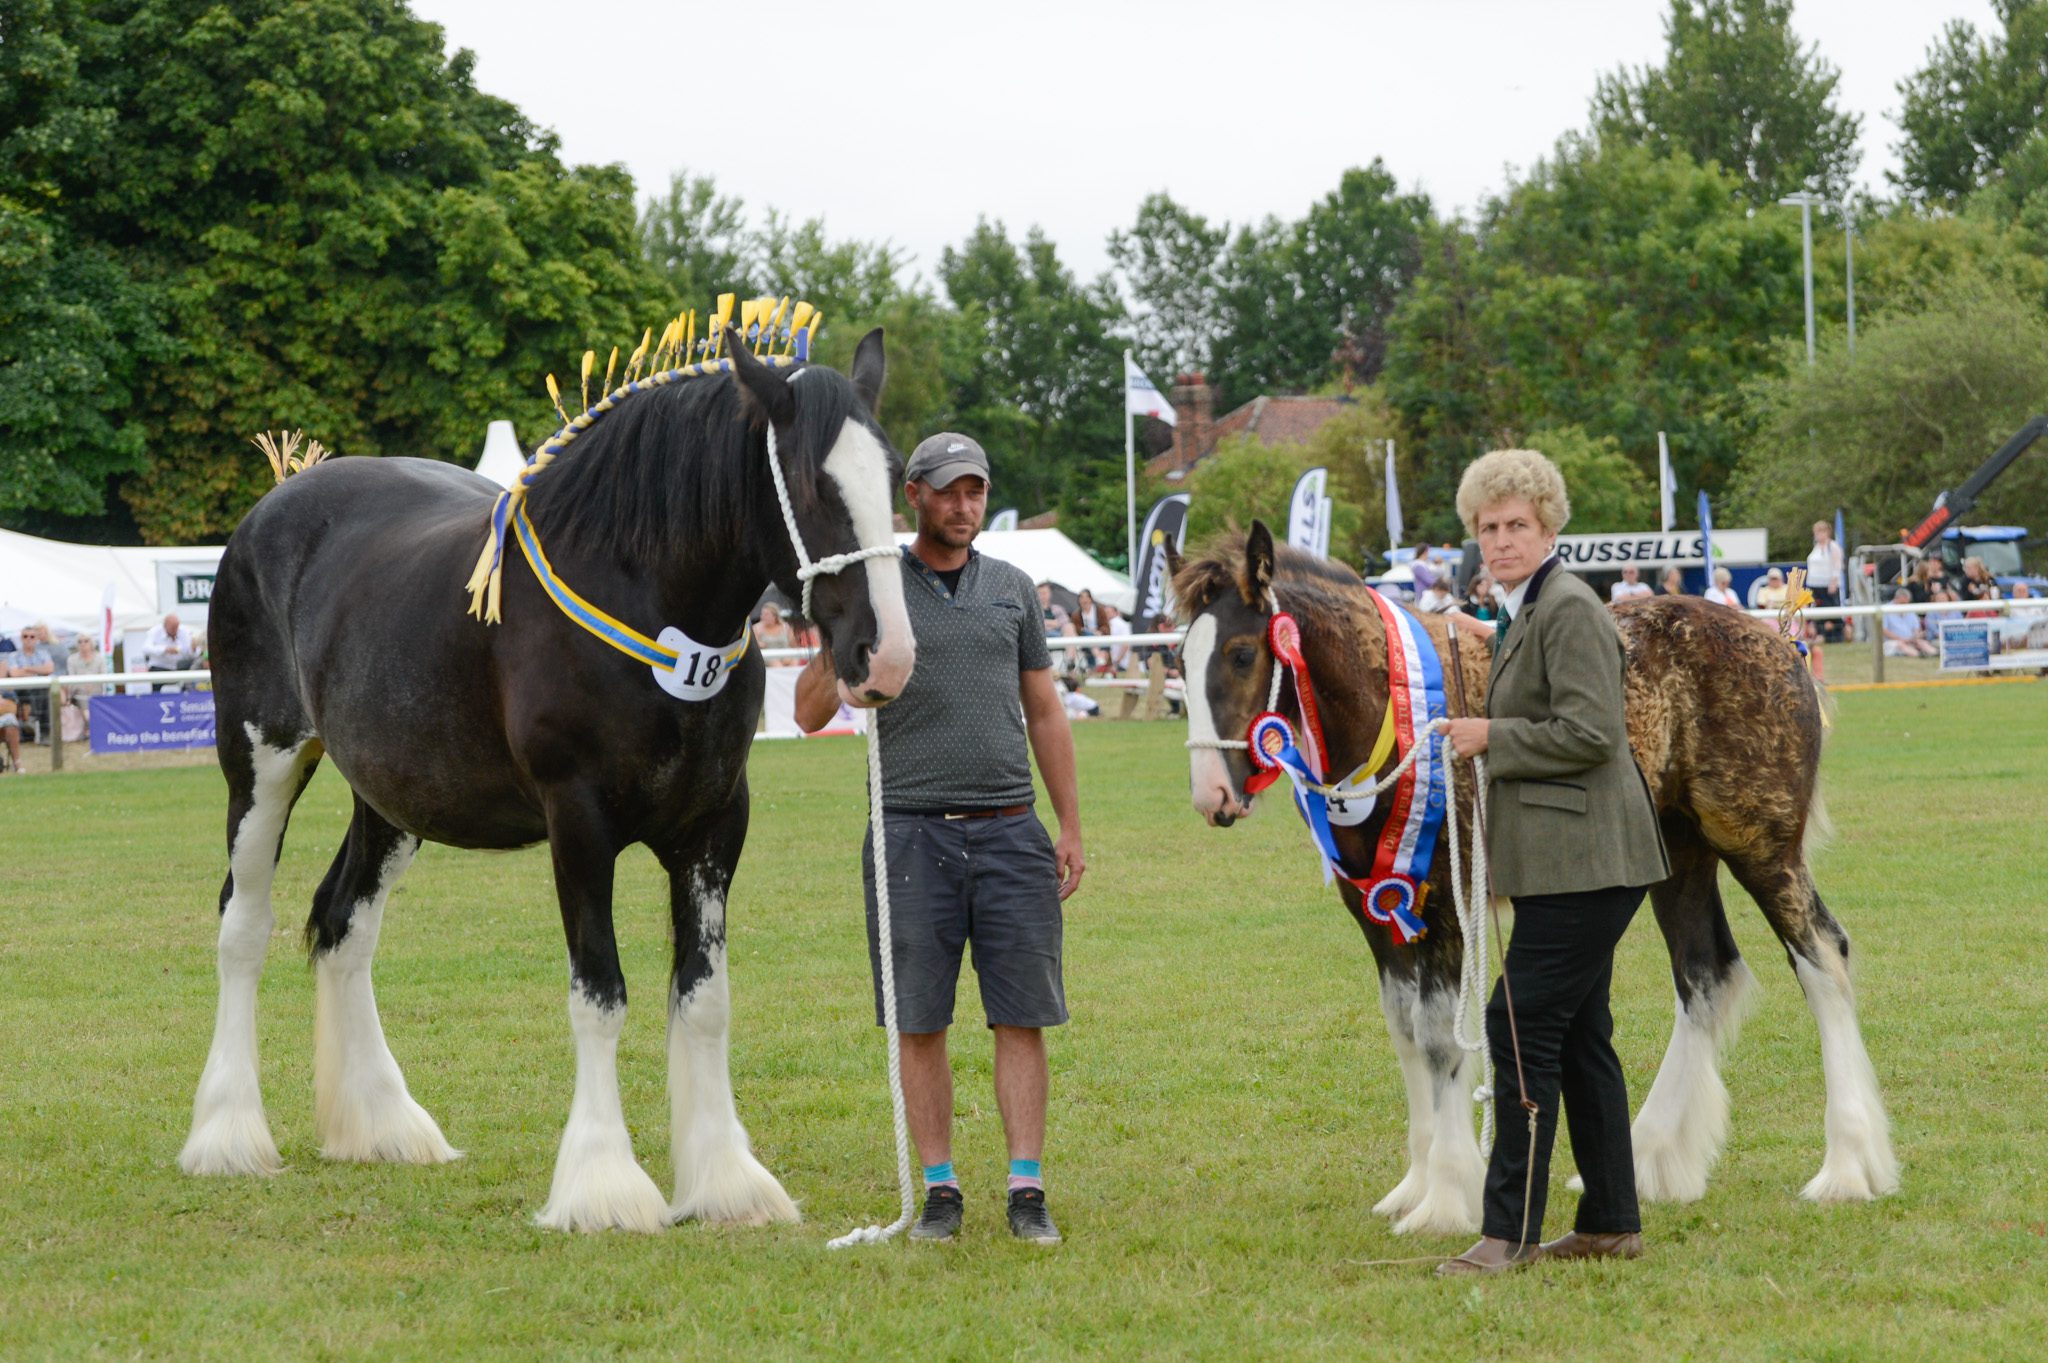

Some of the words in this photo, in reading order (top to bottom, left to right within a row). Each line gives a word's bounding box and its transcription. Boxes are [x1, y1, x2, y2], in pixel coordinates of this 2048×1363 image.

[1557, 538, 1706, 563] RUSSELLS
[183, 579, 215, 599] BR
[683, 651, 721, 688] 18
[107, 731, 138, 745] Reap
[140, 730, 160, 743] the
[162, 727, 210, 742] benefits
[1395, 678, 1414, 780] AICULTURAL
